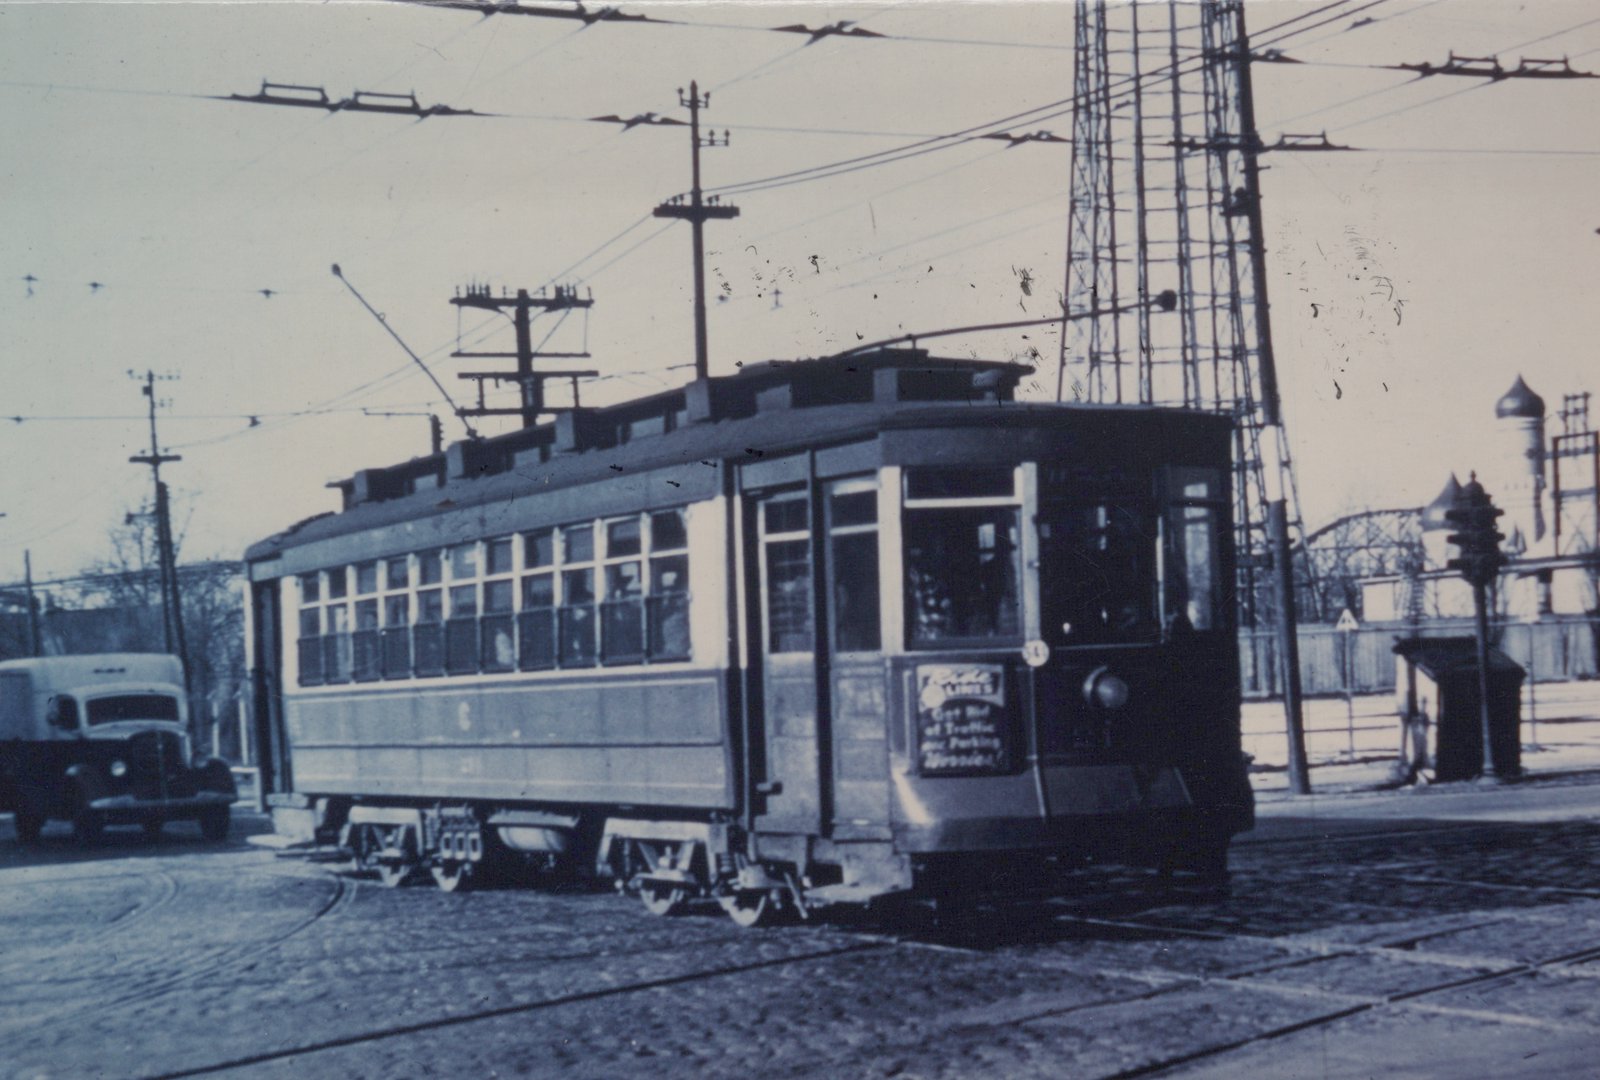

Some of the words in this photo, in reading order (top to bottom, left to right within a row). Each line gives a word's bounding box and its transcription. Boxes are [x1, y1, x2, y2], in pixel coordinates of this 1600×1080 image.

[931, 706, 961, 721] Get
[924, 722, 941, 736] of
[944, 721, 995, 735] Traffic
[949, 737, 1001, 750] Parking
